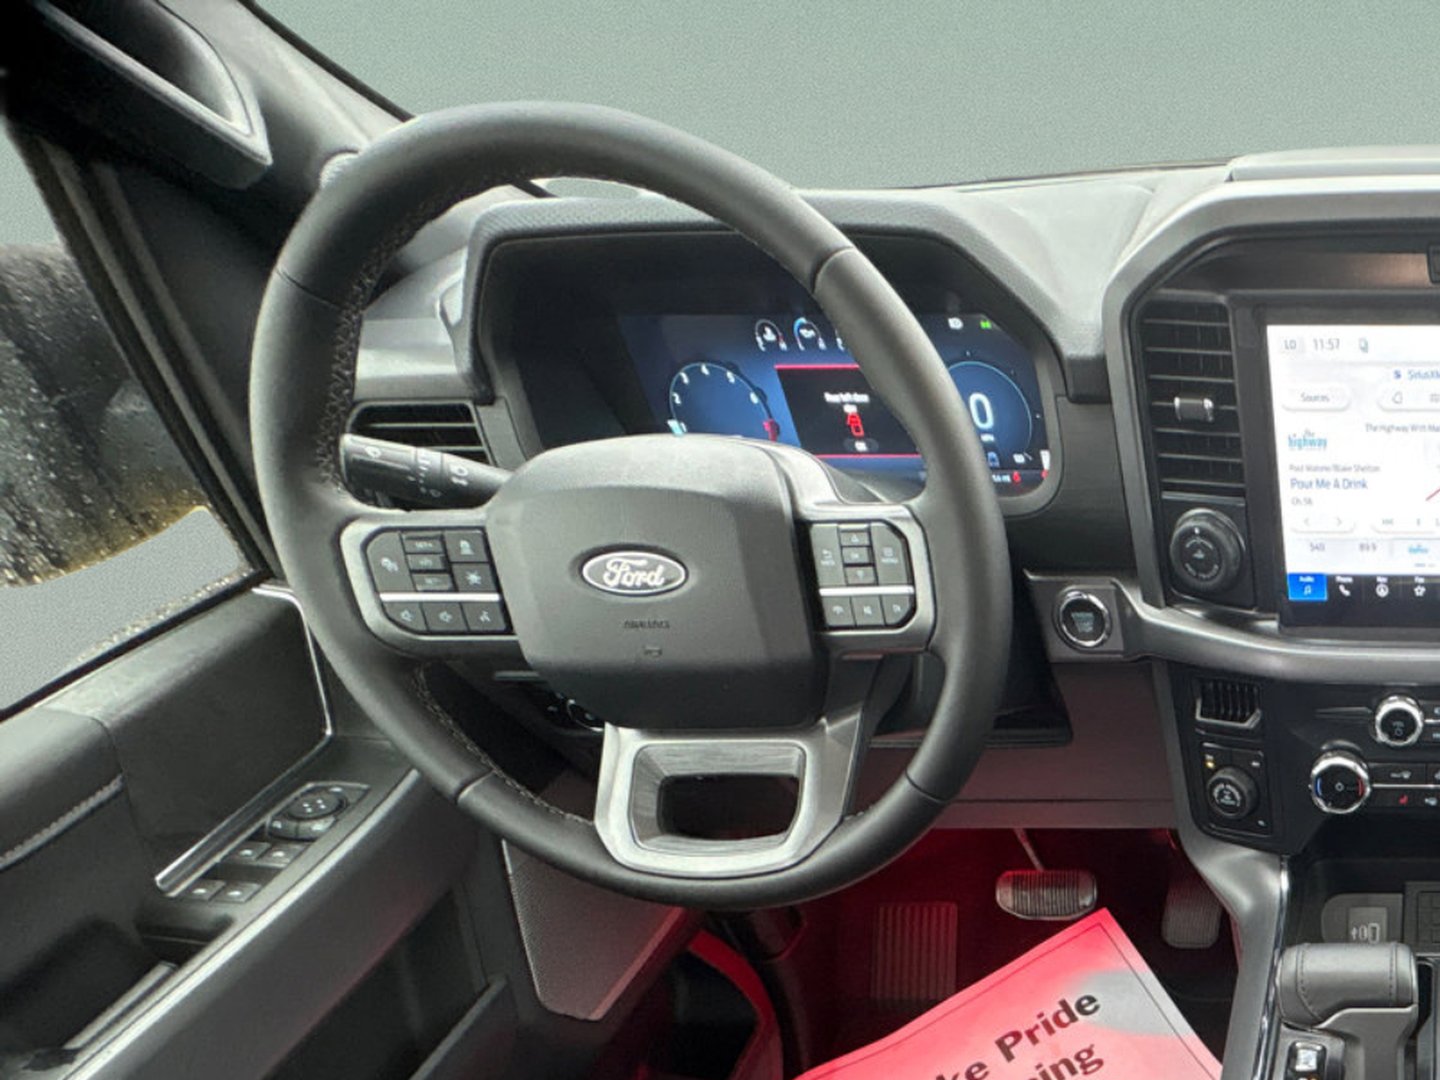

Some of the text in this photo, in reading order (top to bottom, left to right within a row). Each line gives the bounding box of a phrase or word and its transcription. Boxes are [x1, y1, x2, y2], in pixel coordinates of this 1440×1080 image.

[1313, 338, 1340, 350] 11:57
[969, 392, 994, 429] 0
[1287, 434, 1327, 451] highway
[1290, 478, 1368, 490] Pour Me A Drink
[603, 558, 665, 587] Ford
[995, 994, 1101, 1063] Pride
